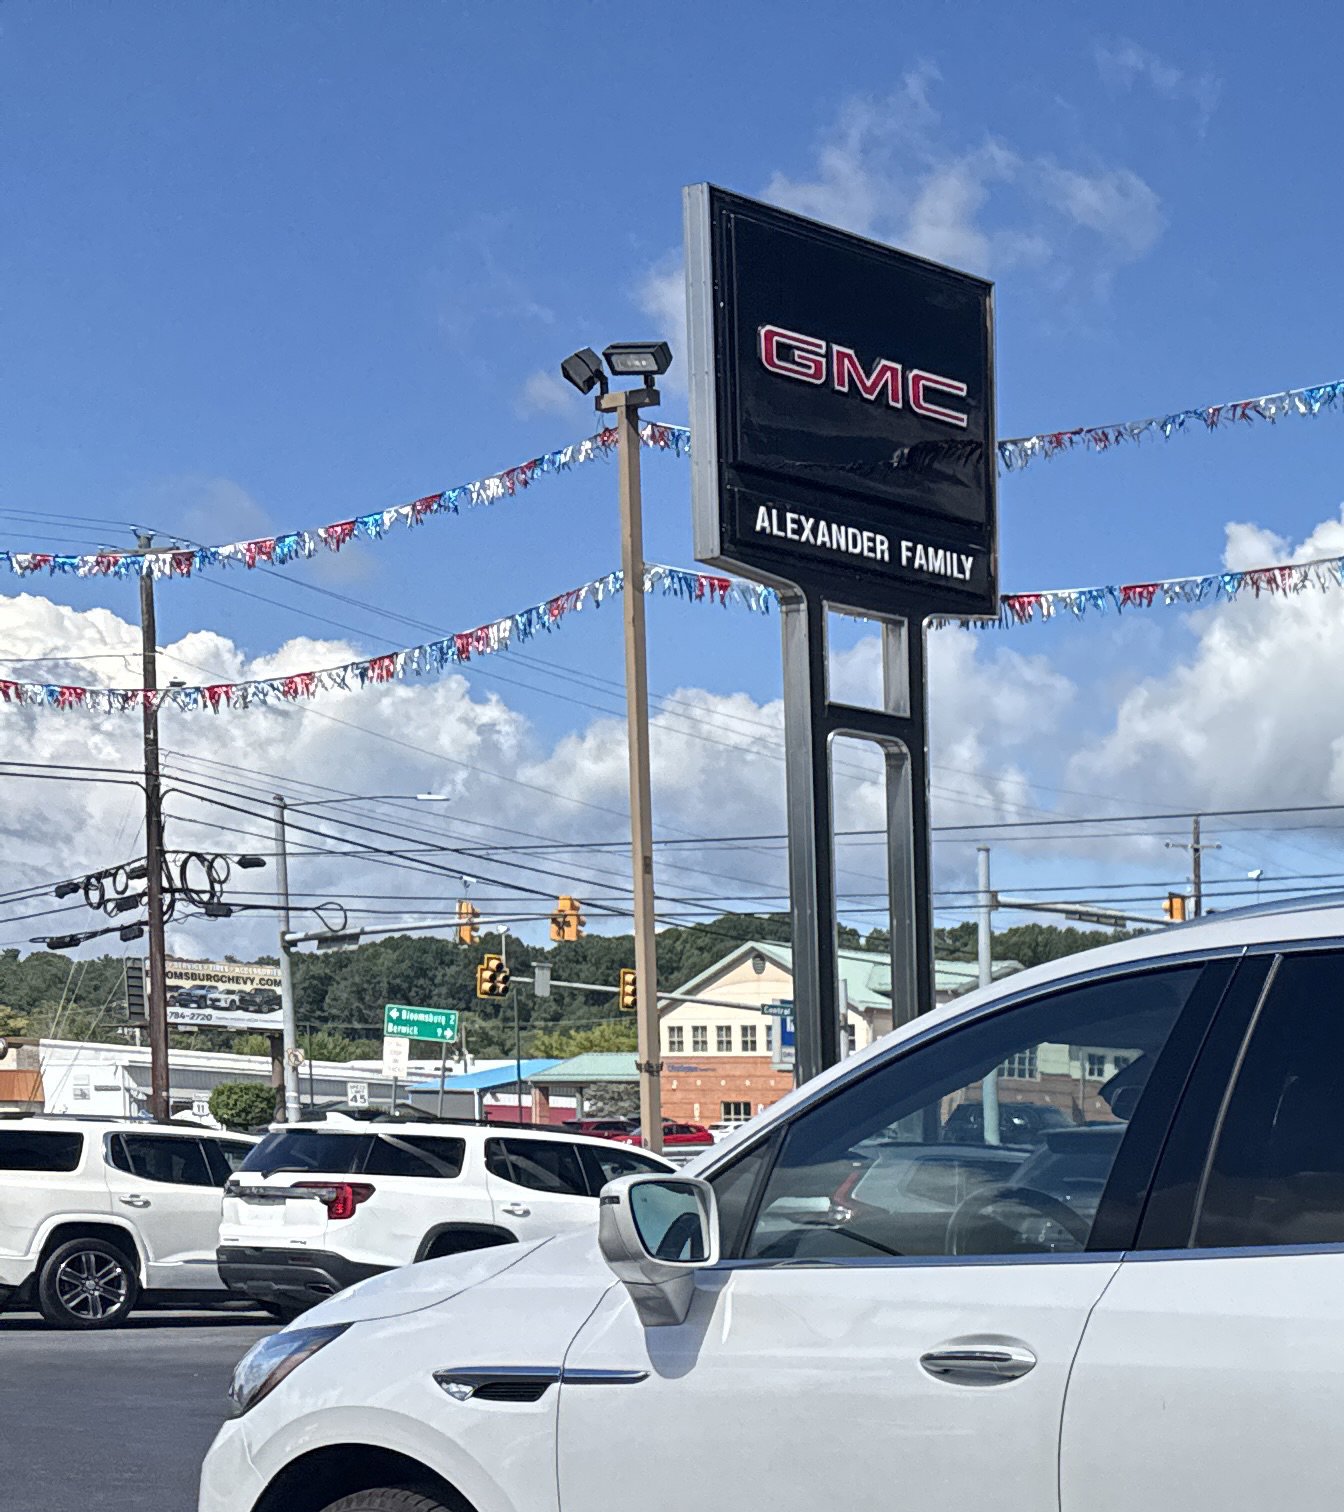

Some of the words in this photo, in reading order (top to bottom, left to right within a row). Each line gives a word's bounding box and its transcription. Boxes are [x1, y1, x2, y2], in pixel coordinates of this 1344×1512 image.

[758, 325, 967, 428] GMC
[755, 506, 890, 562] ALEXANDER
[900, 540, 974, 580] FAMILY
[402, 1010, 446, 1025] Bloomsburg
[450, 1015, 455, 1025] 2
[388, 1023, 418, 1035] Berwick
[350, 1094, 366, 1104] 45
[197, 1104, 204, 1113] 11
